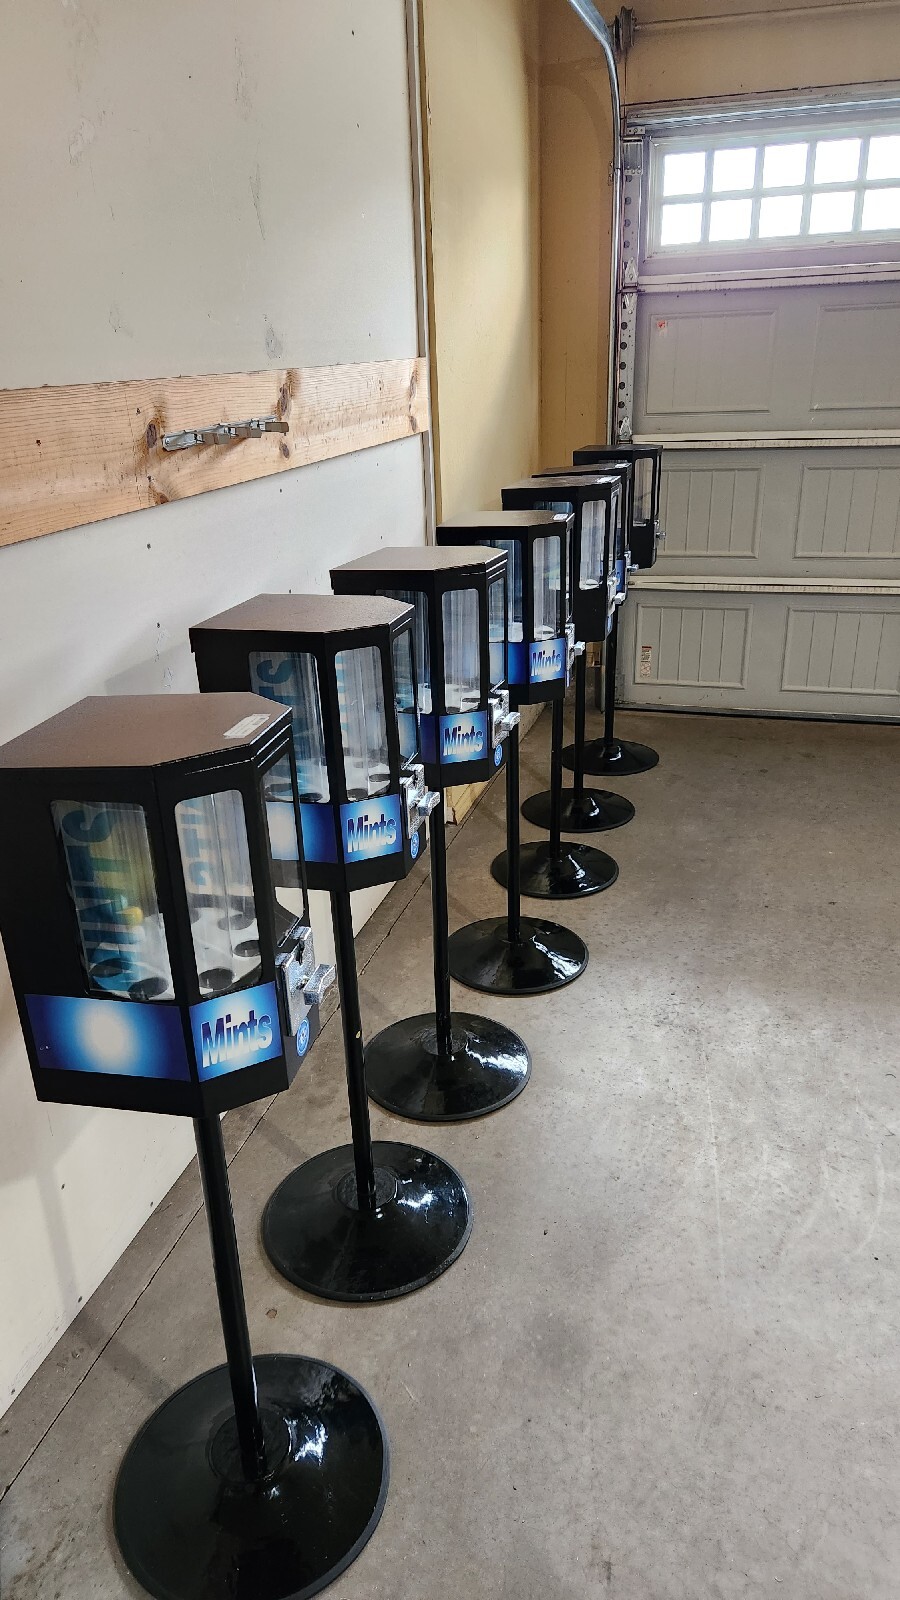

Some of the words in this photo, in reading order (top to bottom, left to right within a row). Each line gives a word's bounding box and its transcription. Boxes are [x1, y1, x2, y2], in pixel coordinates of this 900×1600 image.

[531, 649, 562, 676] Mints
[443, 725, 483, 756] Mints
[347, 813, 396, 853] Mints
[201, 1009, 273, 1068] Mints
